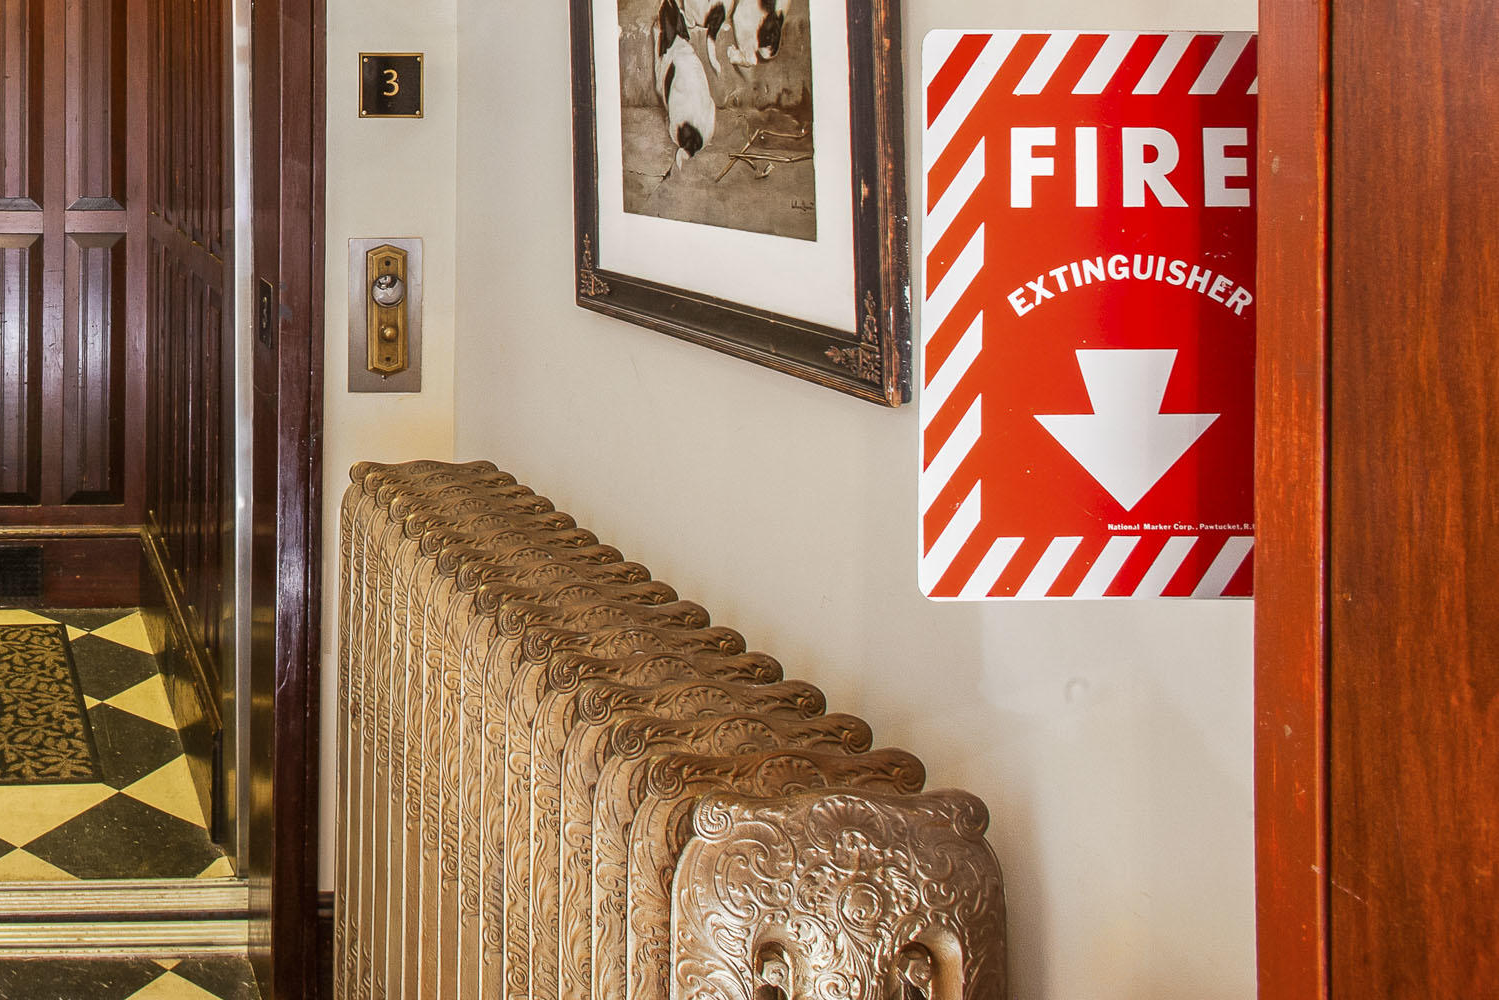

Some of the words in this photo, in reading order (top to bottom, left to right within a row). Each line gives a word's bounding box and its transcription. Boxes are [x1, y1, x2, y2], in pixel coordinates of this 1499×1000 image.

[383, 69, 400, 96] 3
[1009, 126, 1252, 208] FIRE
[1007, 254, 1253, 317] EXTINGUISHER
[1107, 523, 1140, 531] National
[1143, 523, 1171, 531] Marker
